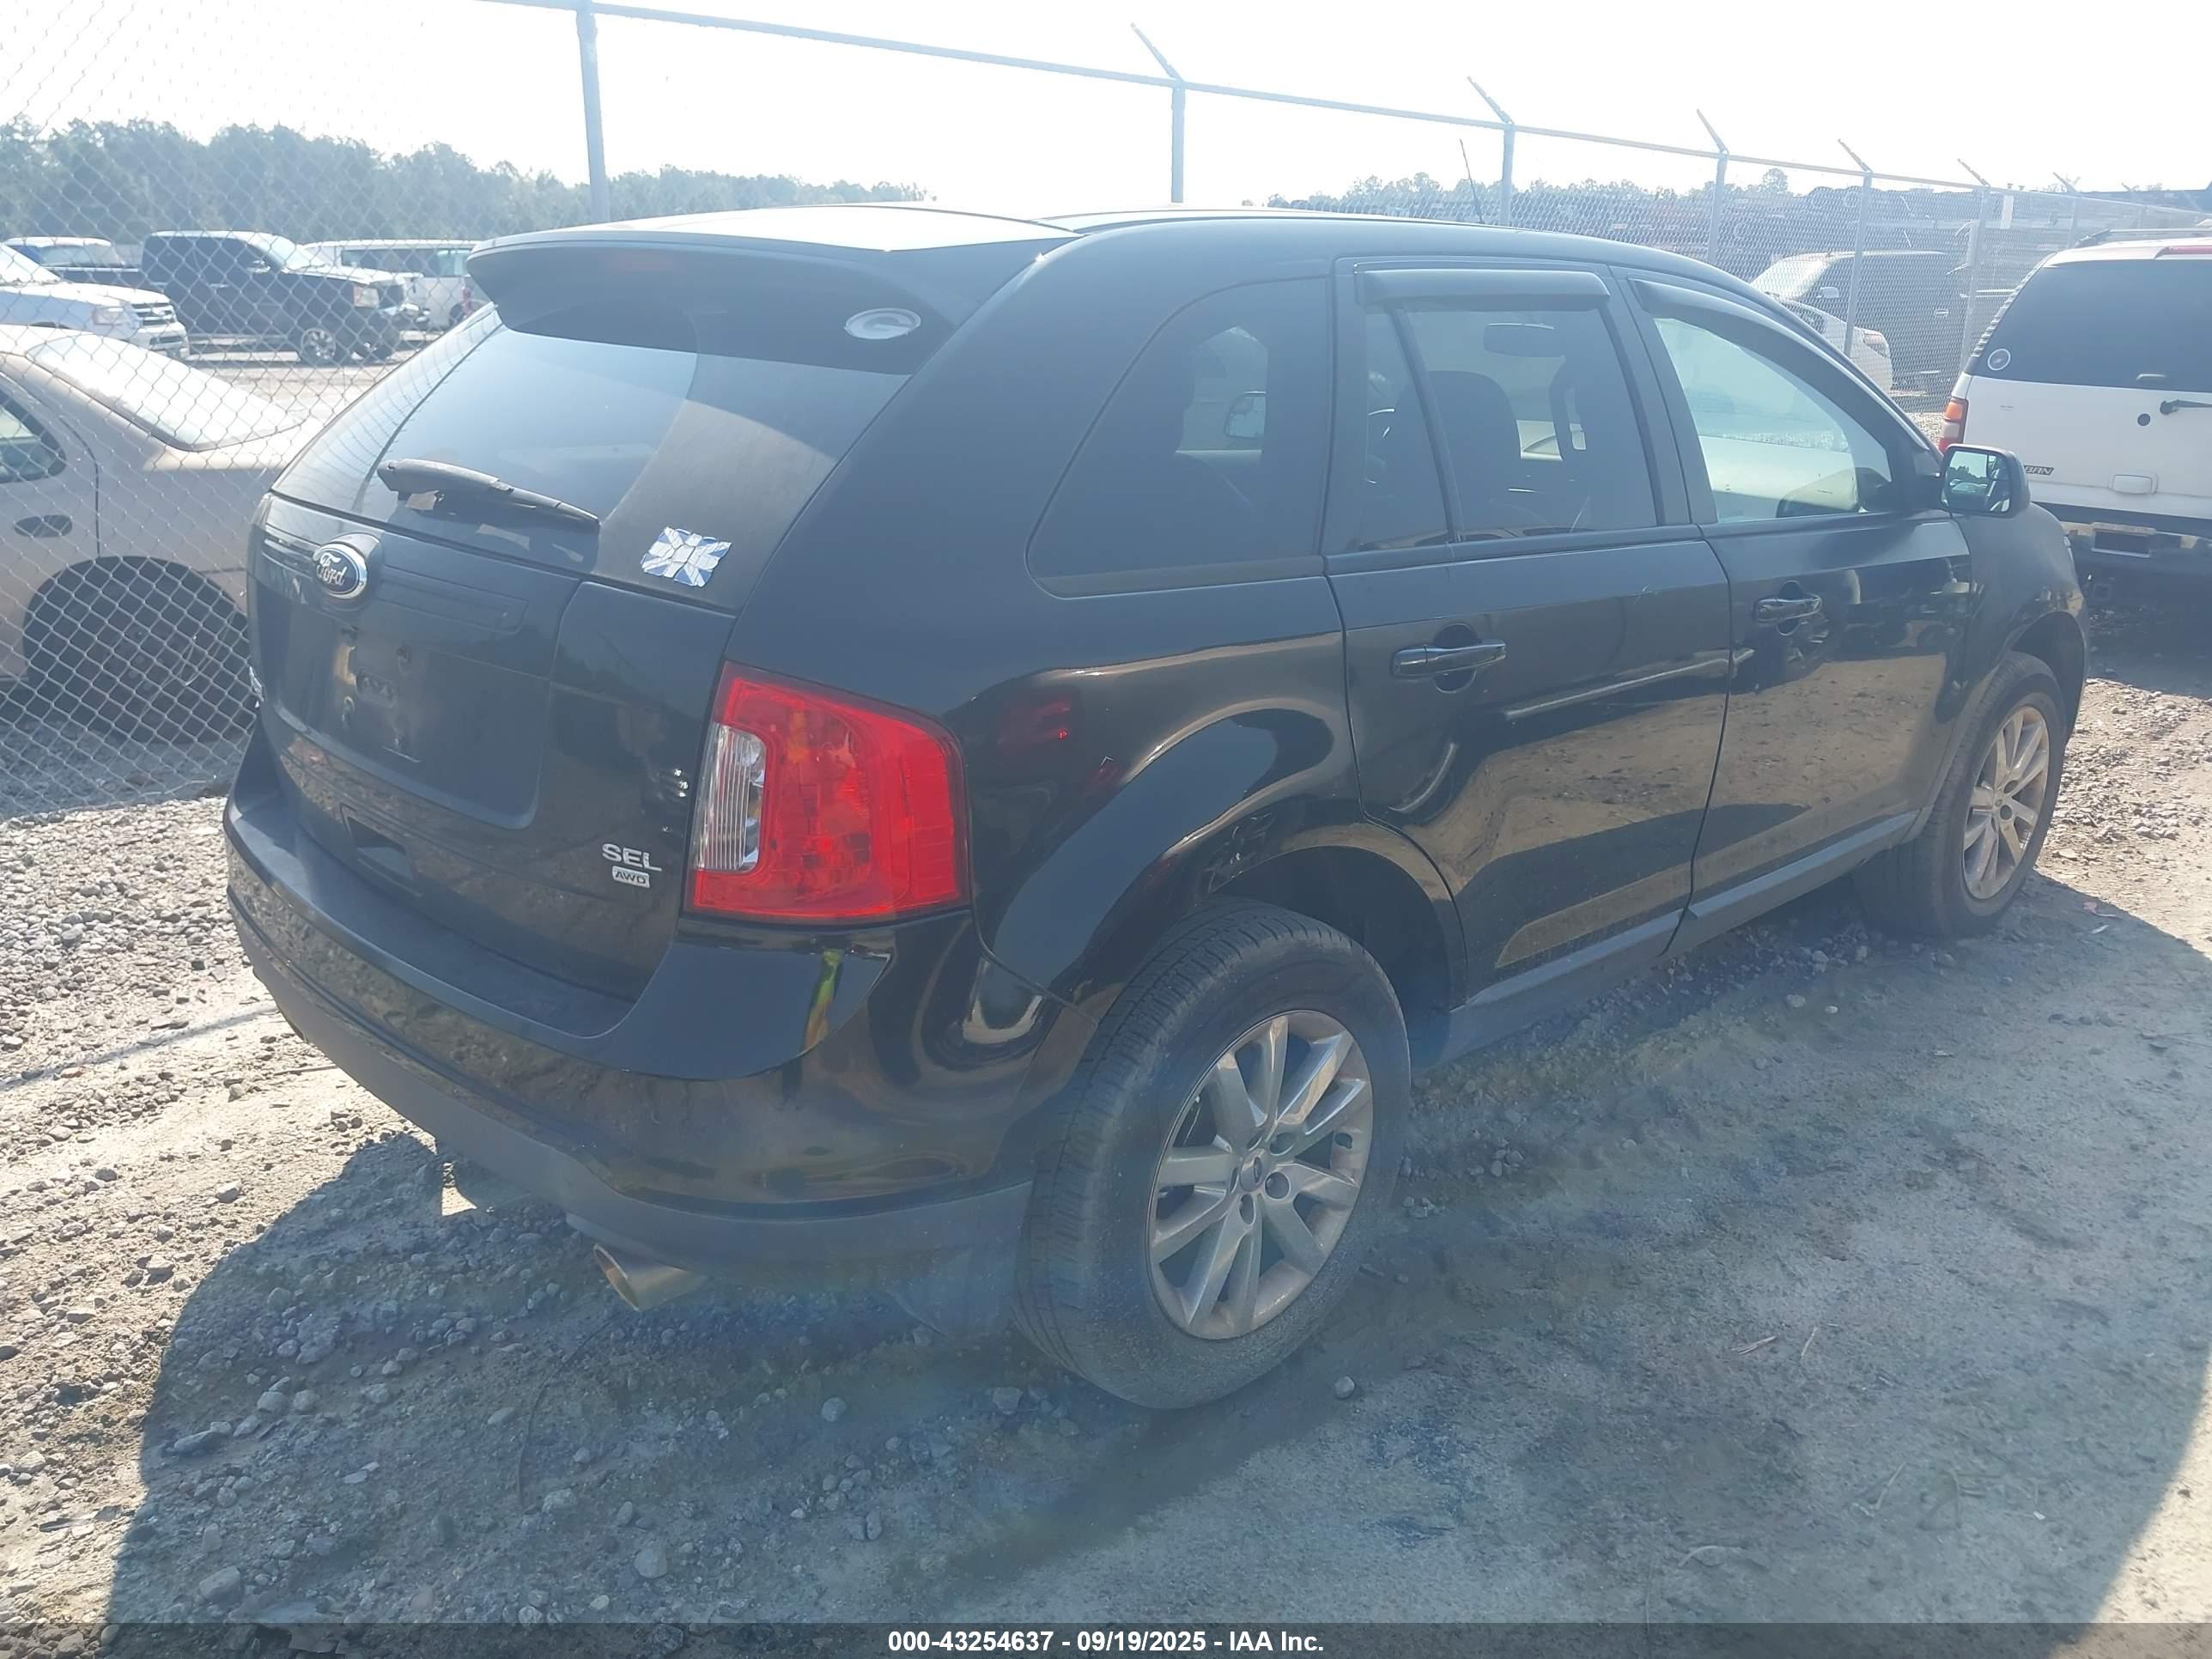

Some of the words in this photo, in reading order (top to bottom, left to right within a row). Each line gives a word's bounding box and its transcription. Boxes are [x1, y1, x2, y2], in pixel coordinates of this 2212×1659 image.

[315, 551, 348, 586] Ford
[602, 843, 662, 872] SEL
[615, 871, 647, 884] AWD
